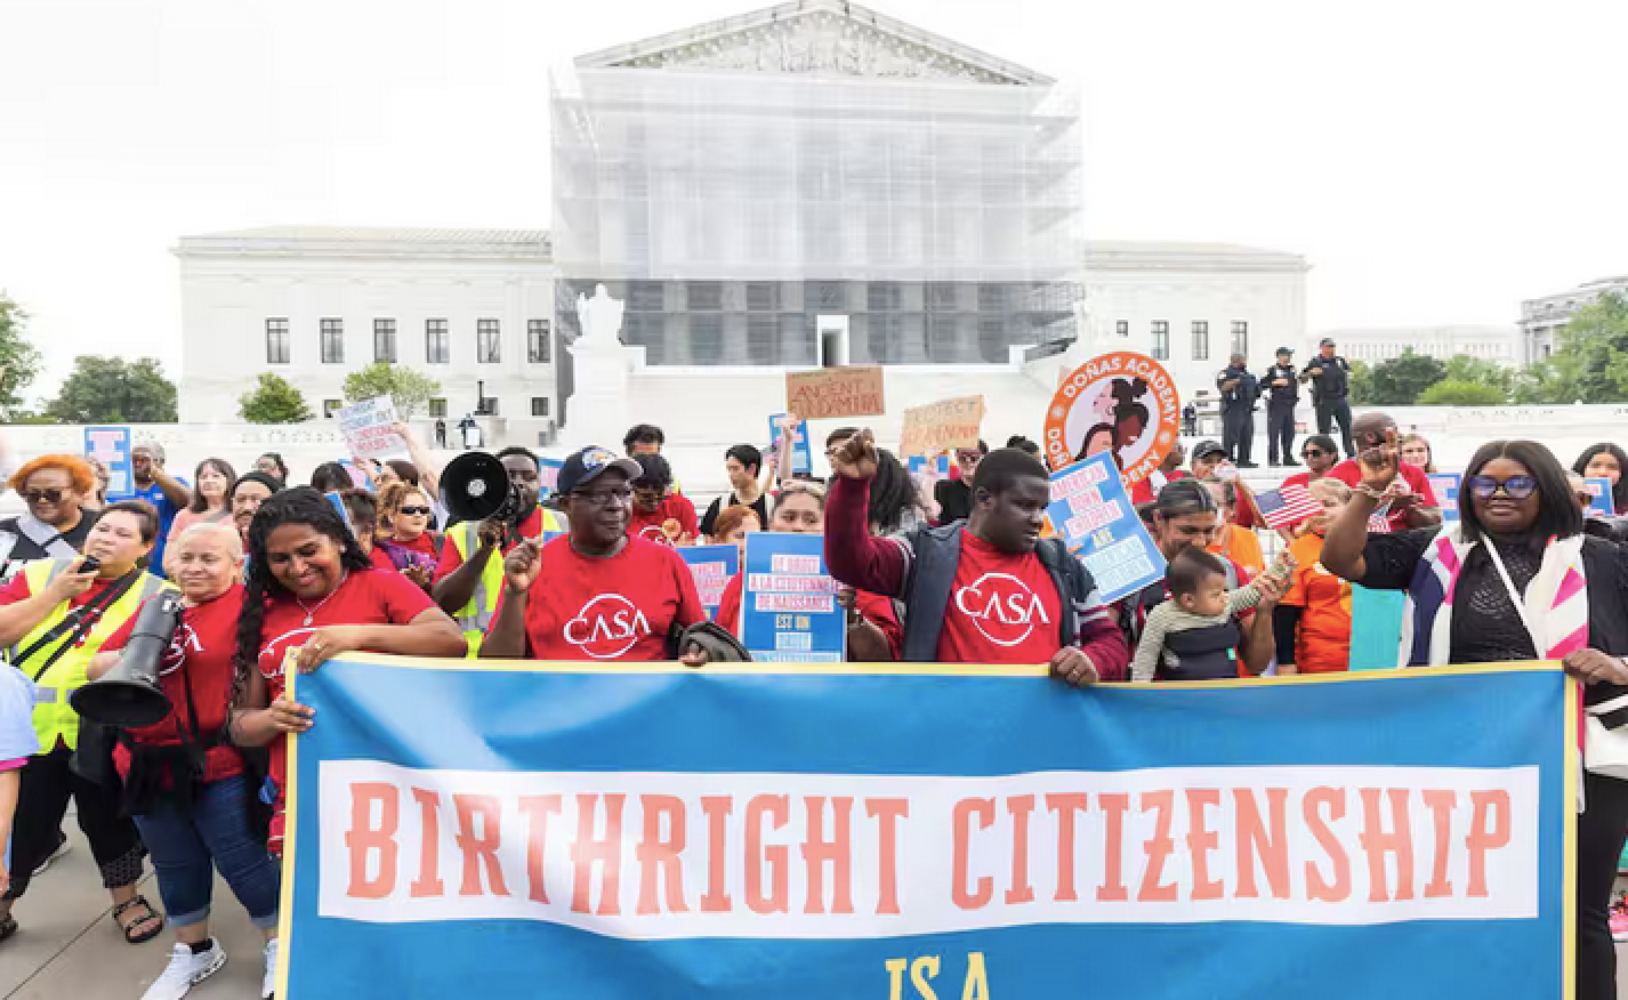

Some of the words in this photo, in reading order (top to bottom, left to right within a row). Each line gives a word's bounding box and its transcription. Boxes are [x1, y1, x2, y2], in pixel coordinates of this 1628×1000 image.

[1062, 357, 1121, 398] DOÑAS
[1125, 358, 1177, 423] ACADEMY
[564, 609, 651, 645] CASA
[956, 585, 1050, 624] CASA
[345, 782, 909, 916] BIRTHRIGHT
[951, 786, 1511, 910] CITIZENSHIP
[885, 954, 941, 1000] IS
